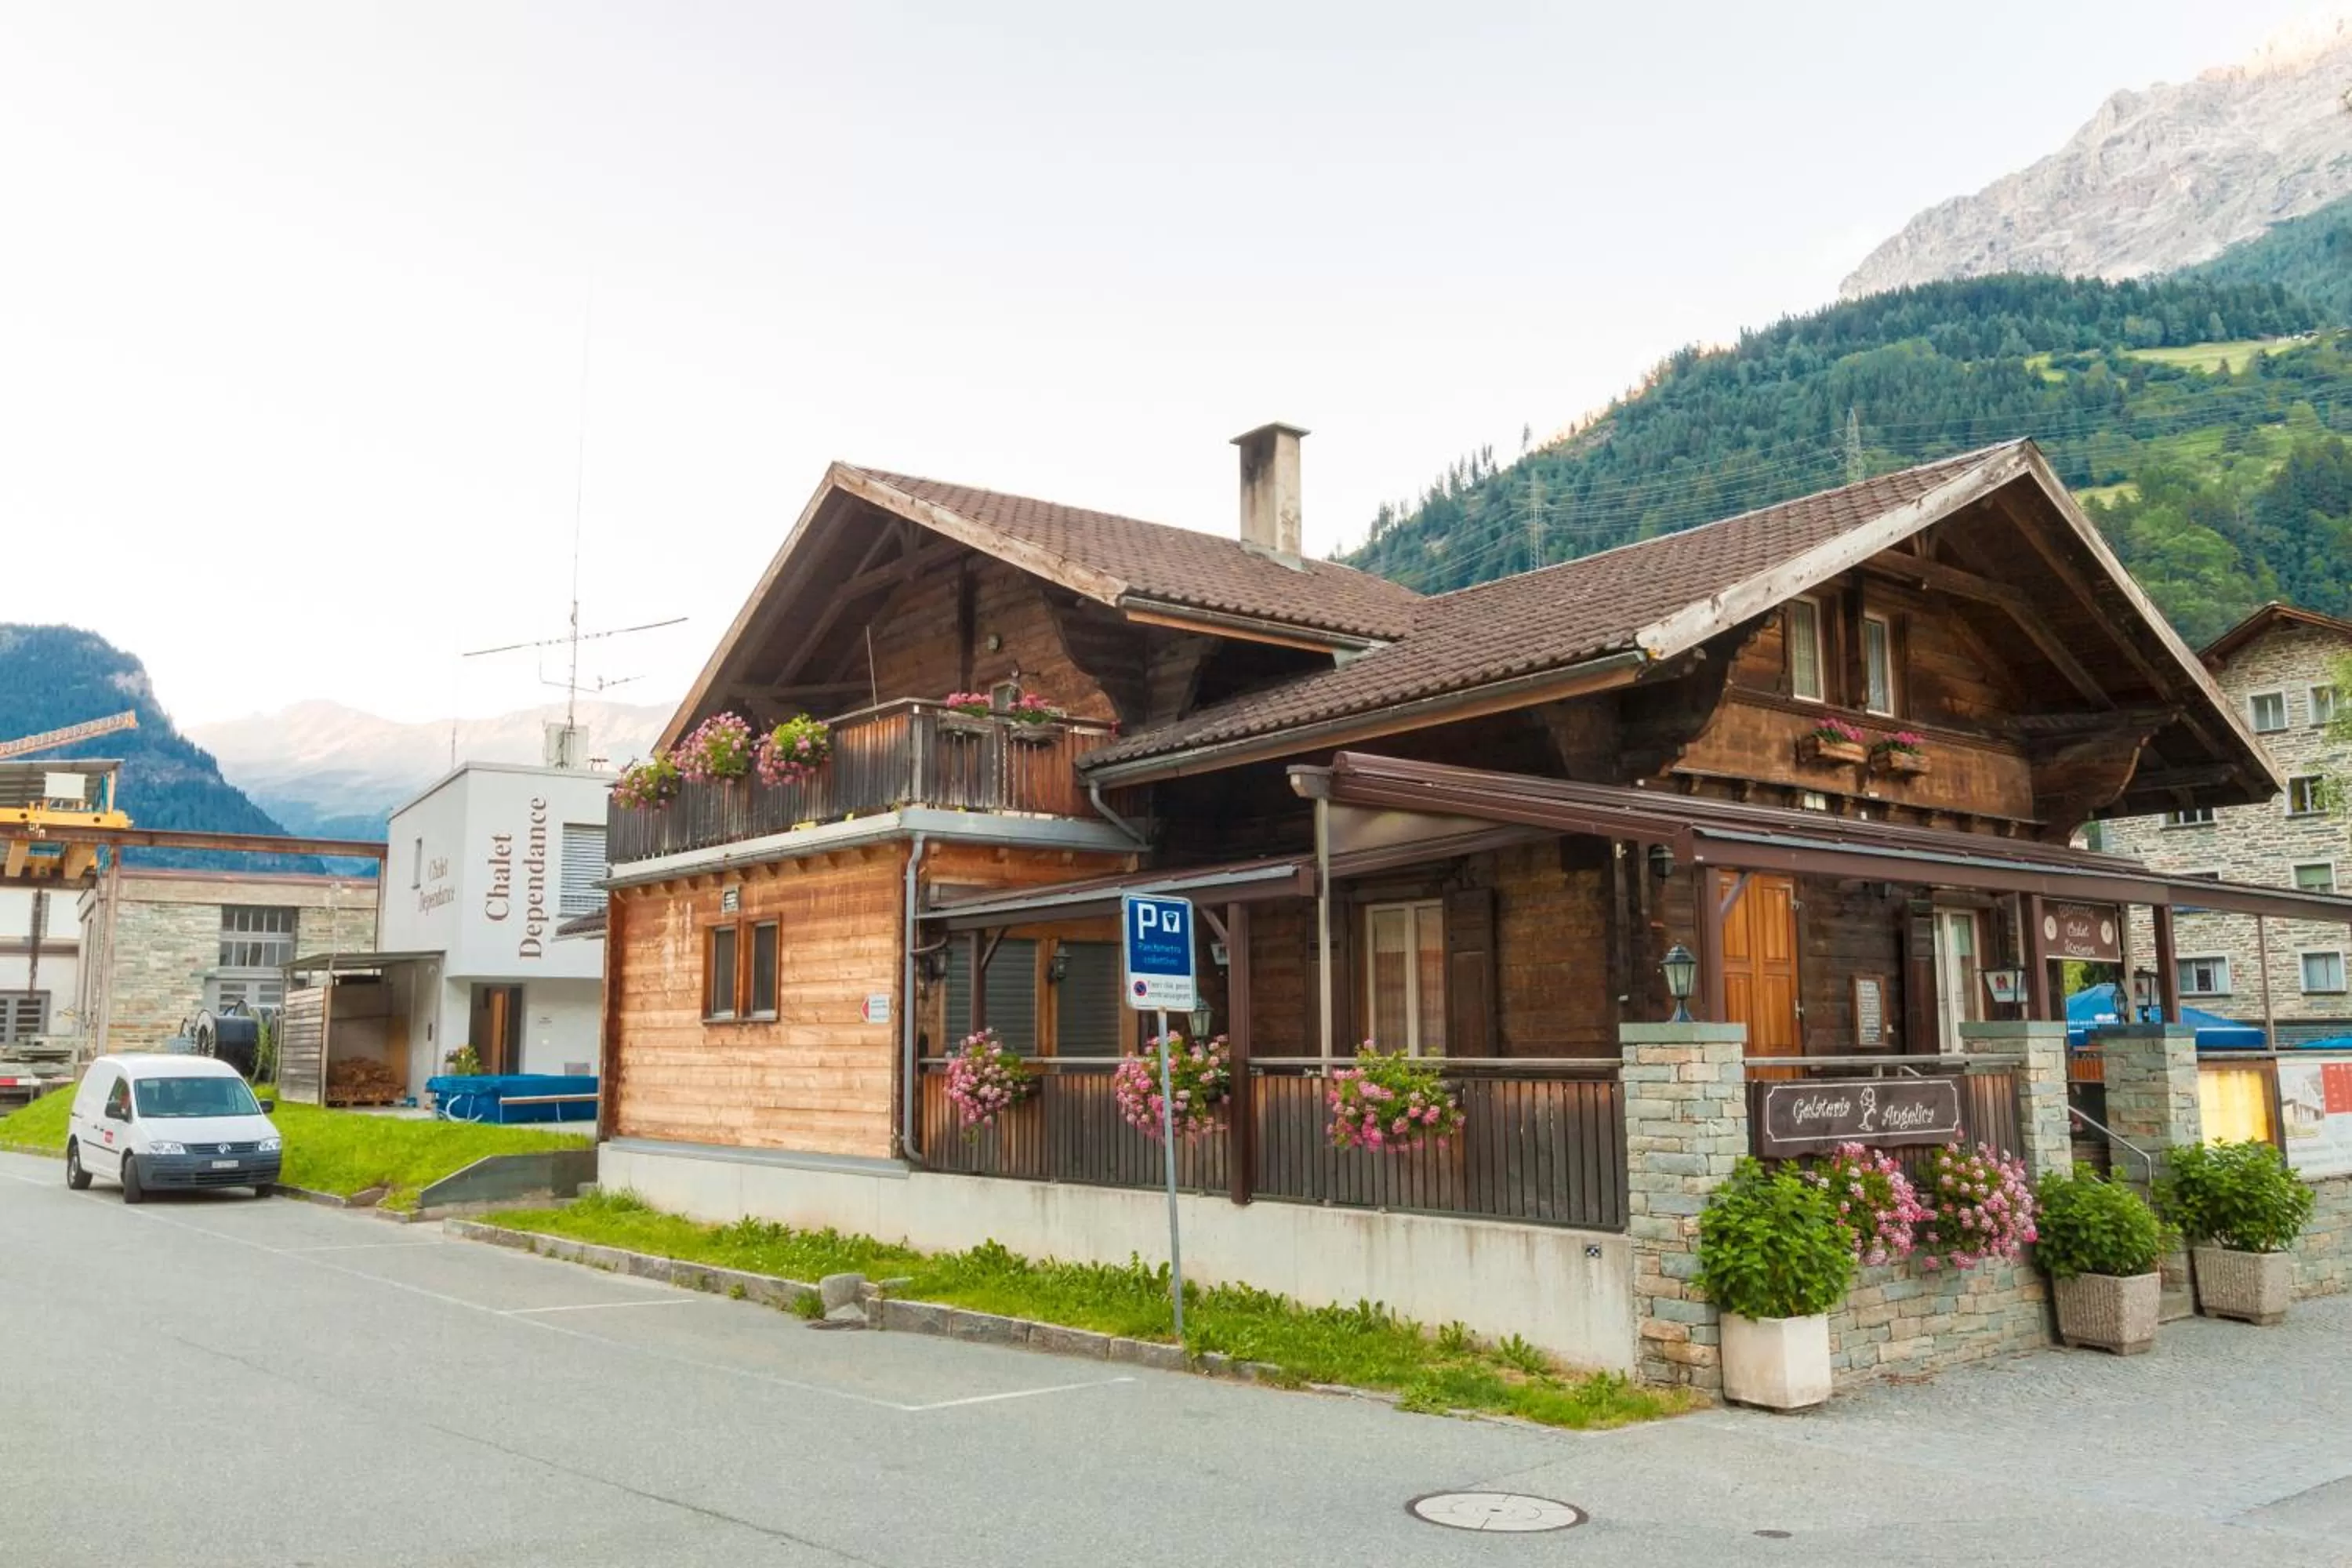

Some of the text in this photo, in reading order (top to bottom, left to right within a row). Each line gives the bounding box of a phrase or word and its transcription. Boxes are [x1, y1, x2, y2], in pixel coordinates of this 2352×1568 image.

[485, 833, 512, 921] Chalet
[518, 797, 550, 960] Dependance
[1138, 902, 1157, 939] P
[1793, 1094, 1935, 1130] Gelateria Angelica
